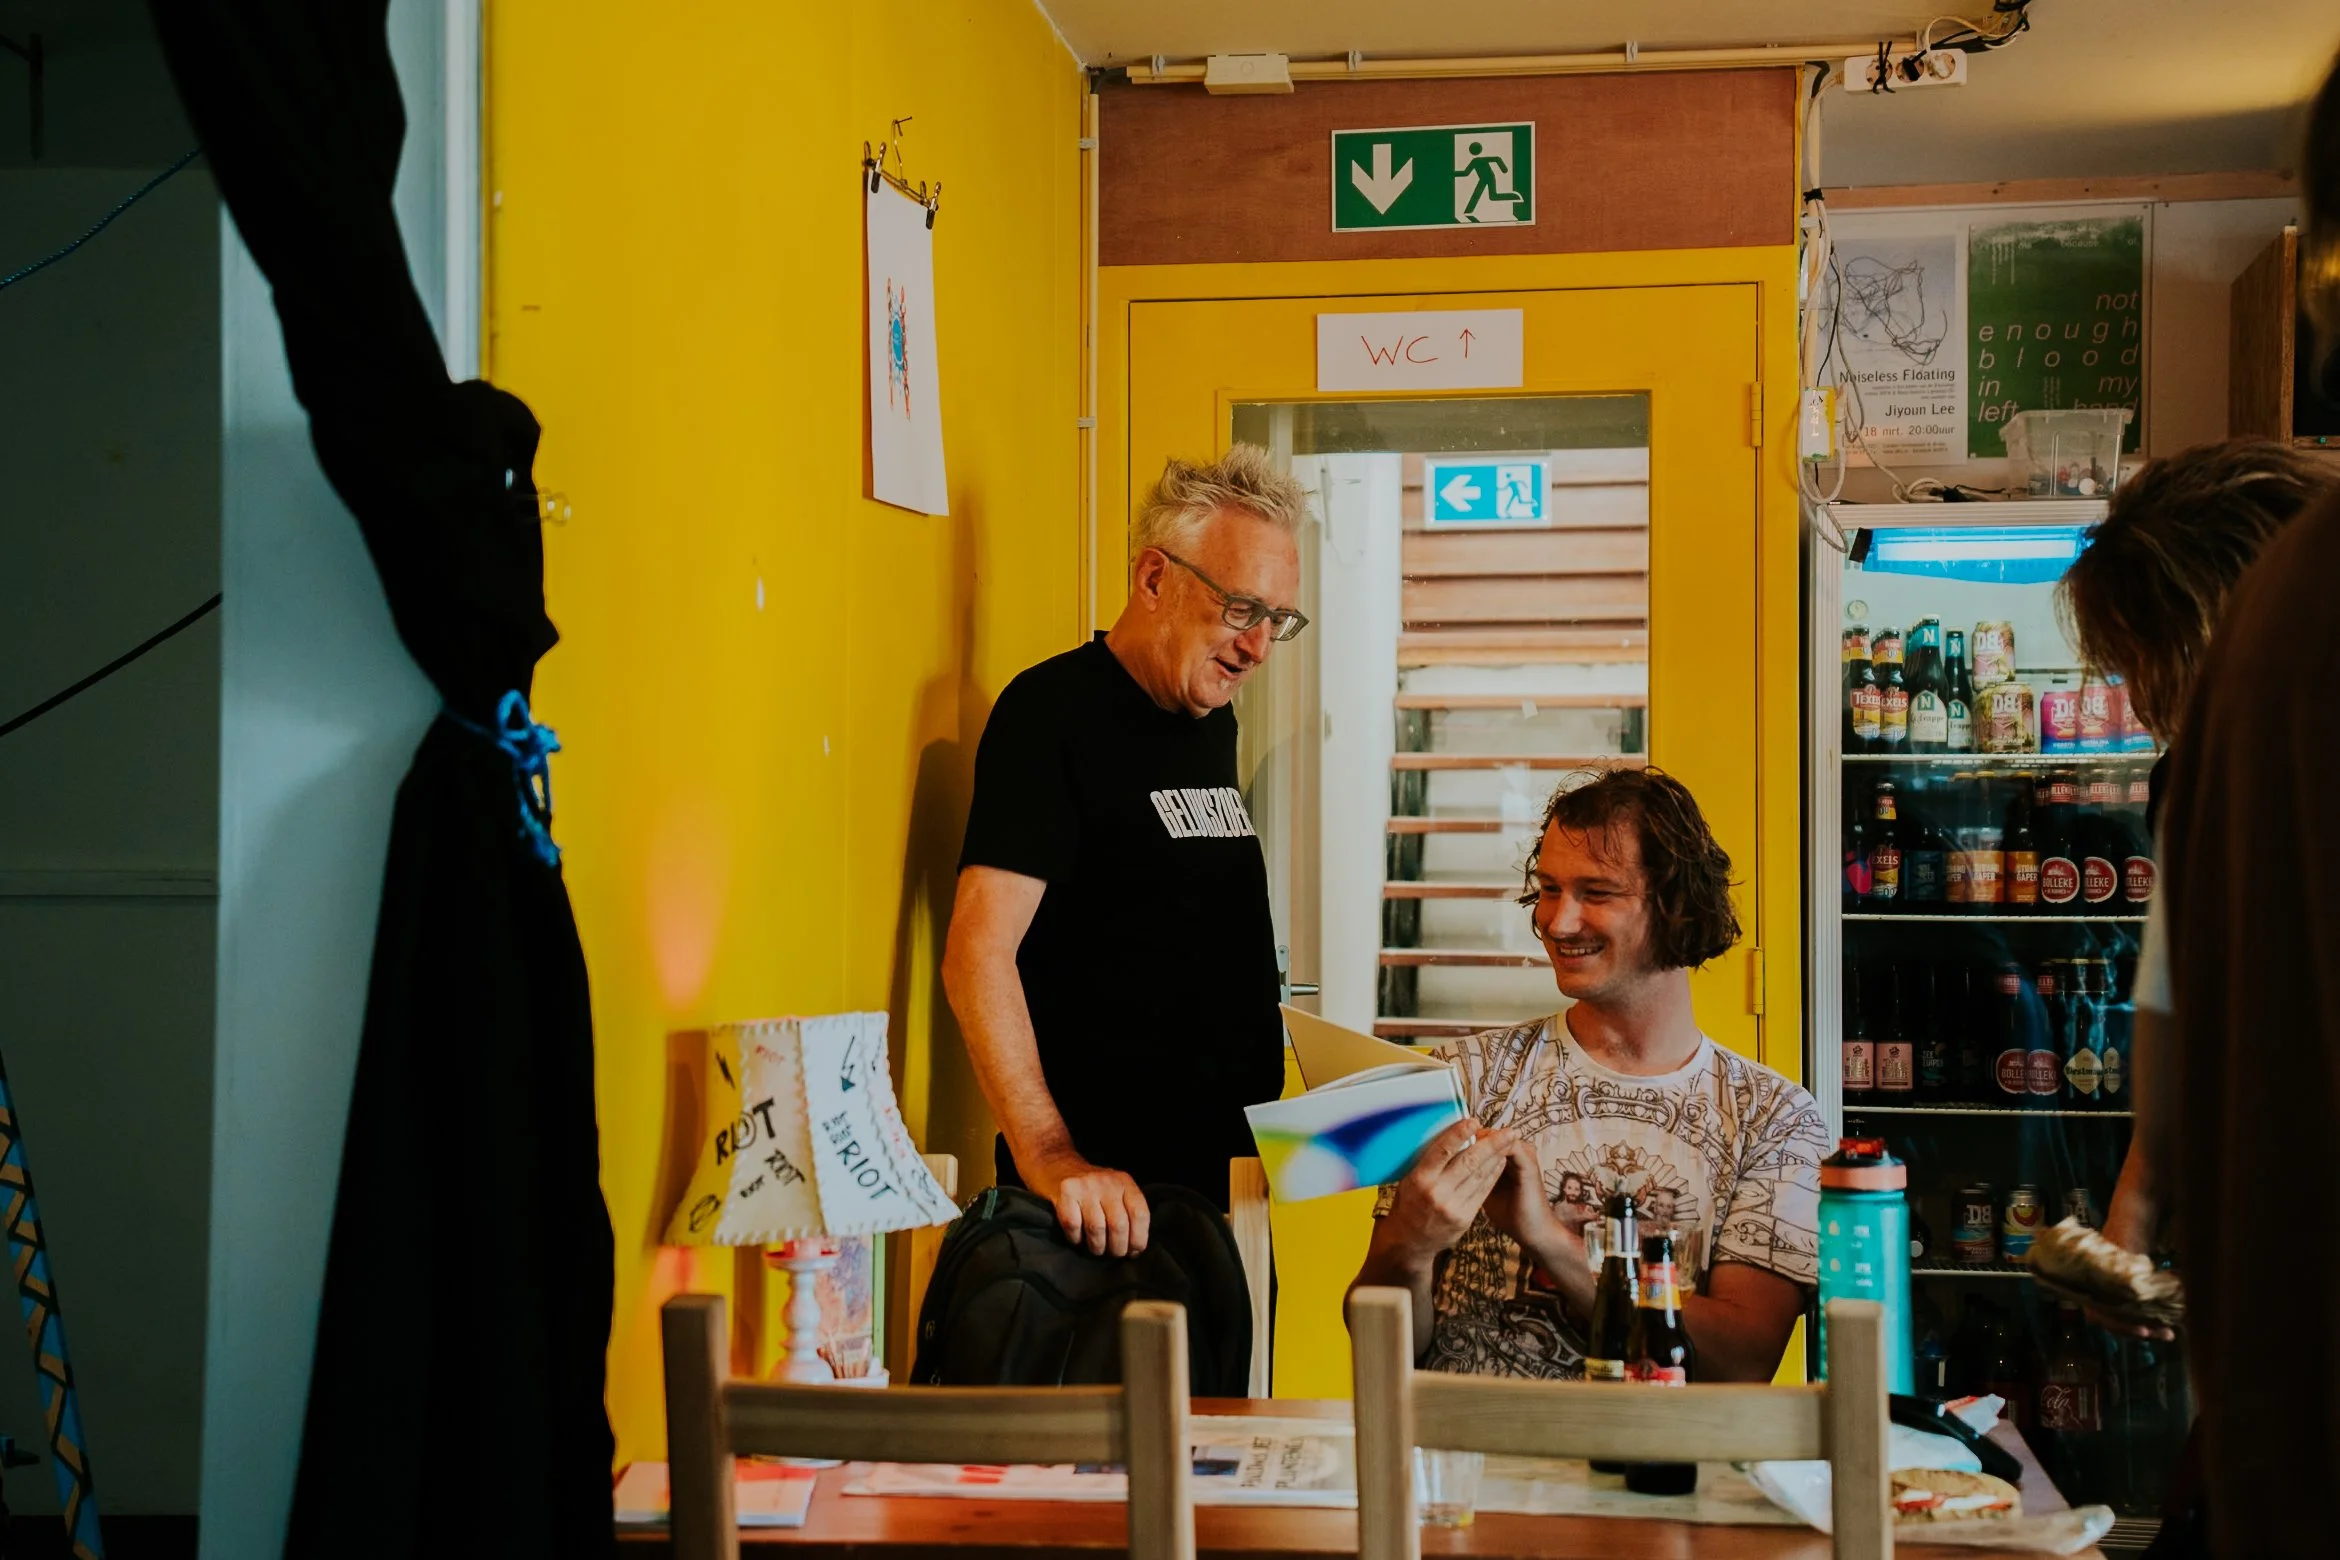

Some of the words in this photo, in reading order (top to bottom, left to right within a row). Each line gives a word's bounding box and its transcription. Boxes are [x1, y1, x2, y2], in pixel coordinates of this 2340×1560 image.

[2096, 290, 2139, 311] not
[1978, 316, 2139, 344] enough
[1360, 335, 1439, 367] WC
[1978, 343, 2139, 370] blood
[1840, 370, 1898, 384] Noiseless
[1903, 367, 1955, 383] Floating
[1978, 376, 2000, 397] in
[2097, 376, 2138, 398] my
[1885, 405, 1926, 418] Jiyoun
[1931, 402, 1956, 415] Lee
[1978, 400, 2020, 423] left
[1865, 427, 1878, 437] 18
[1908, 424, 1955, 436] 20:00uur
[836, 1140, 899, 1200] RIOT
